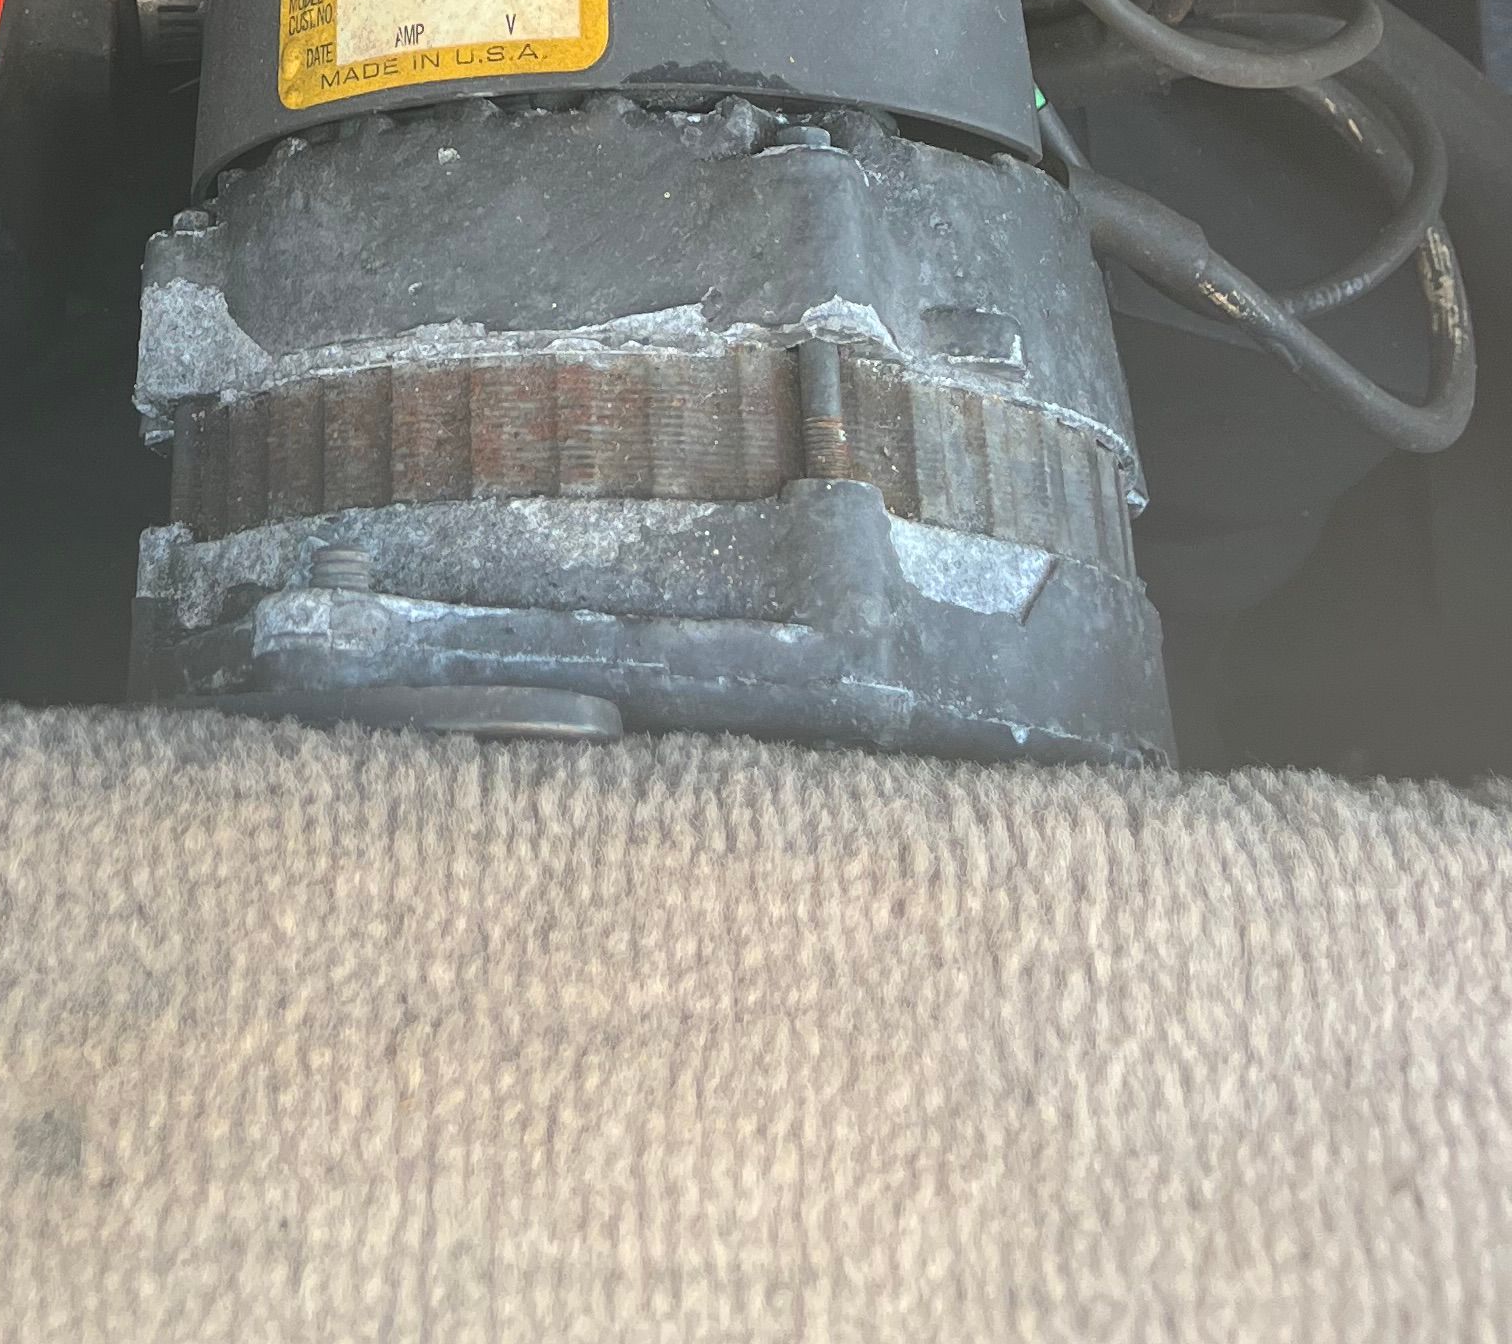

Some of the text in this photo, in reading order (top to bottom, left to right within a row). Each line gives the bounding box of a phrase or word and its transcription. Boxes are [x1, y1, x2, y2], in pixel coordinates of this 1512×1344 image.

[394, 13, 517, 49] AMP V
[306, 41, 334, 69] DATE
[320, 58, 399, 90] MADE
[412, 53, 440, 71] IN
